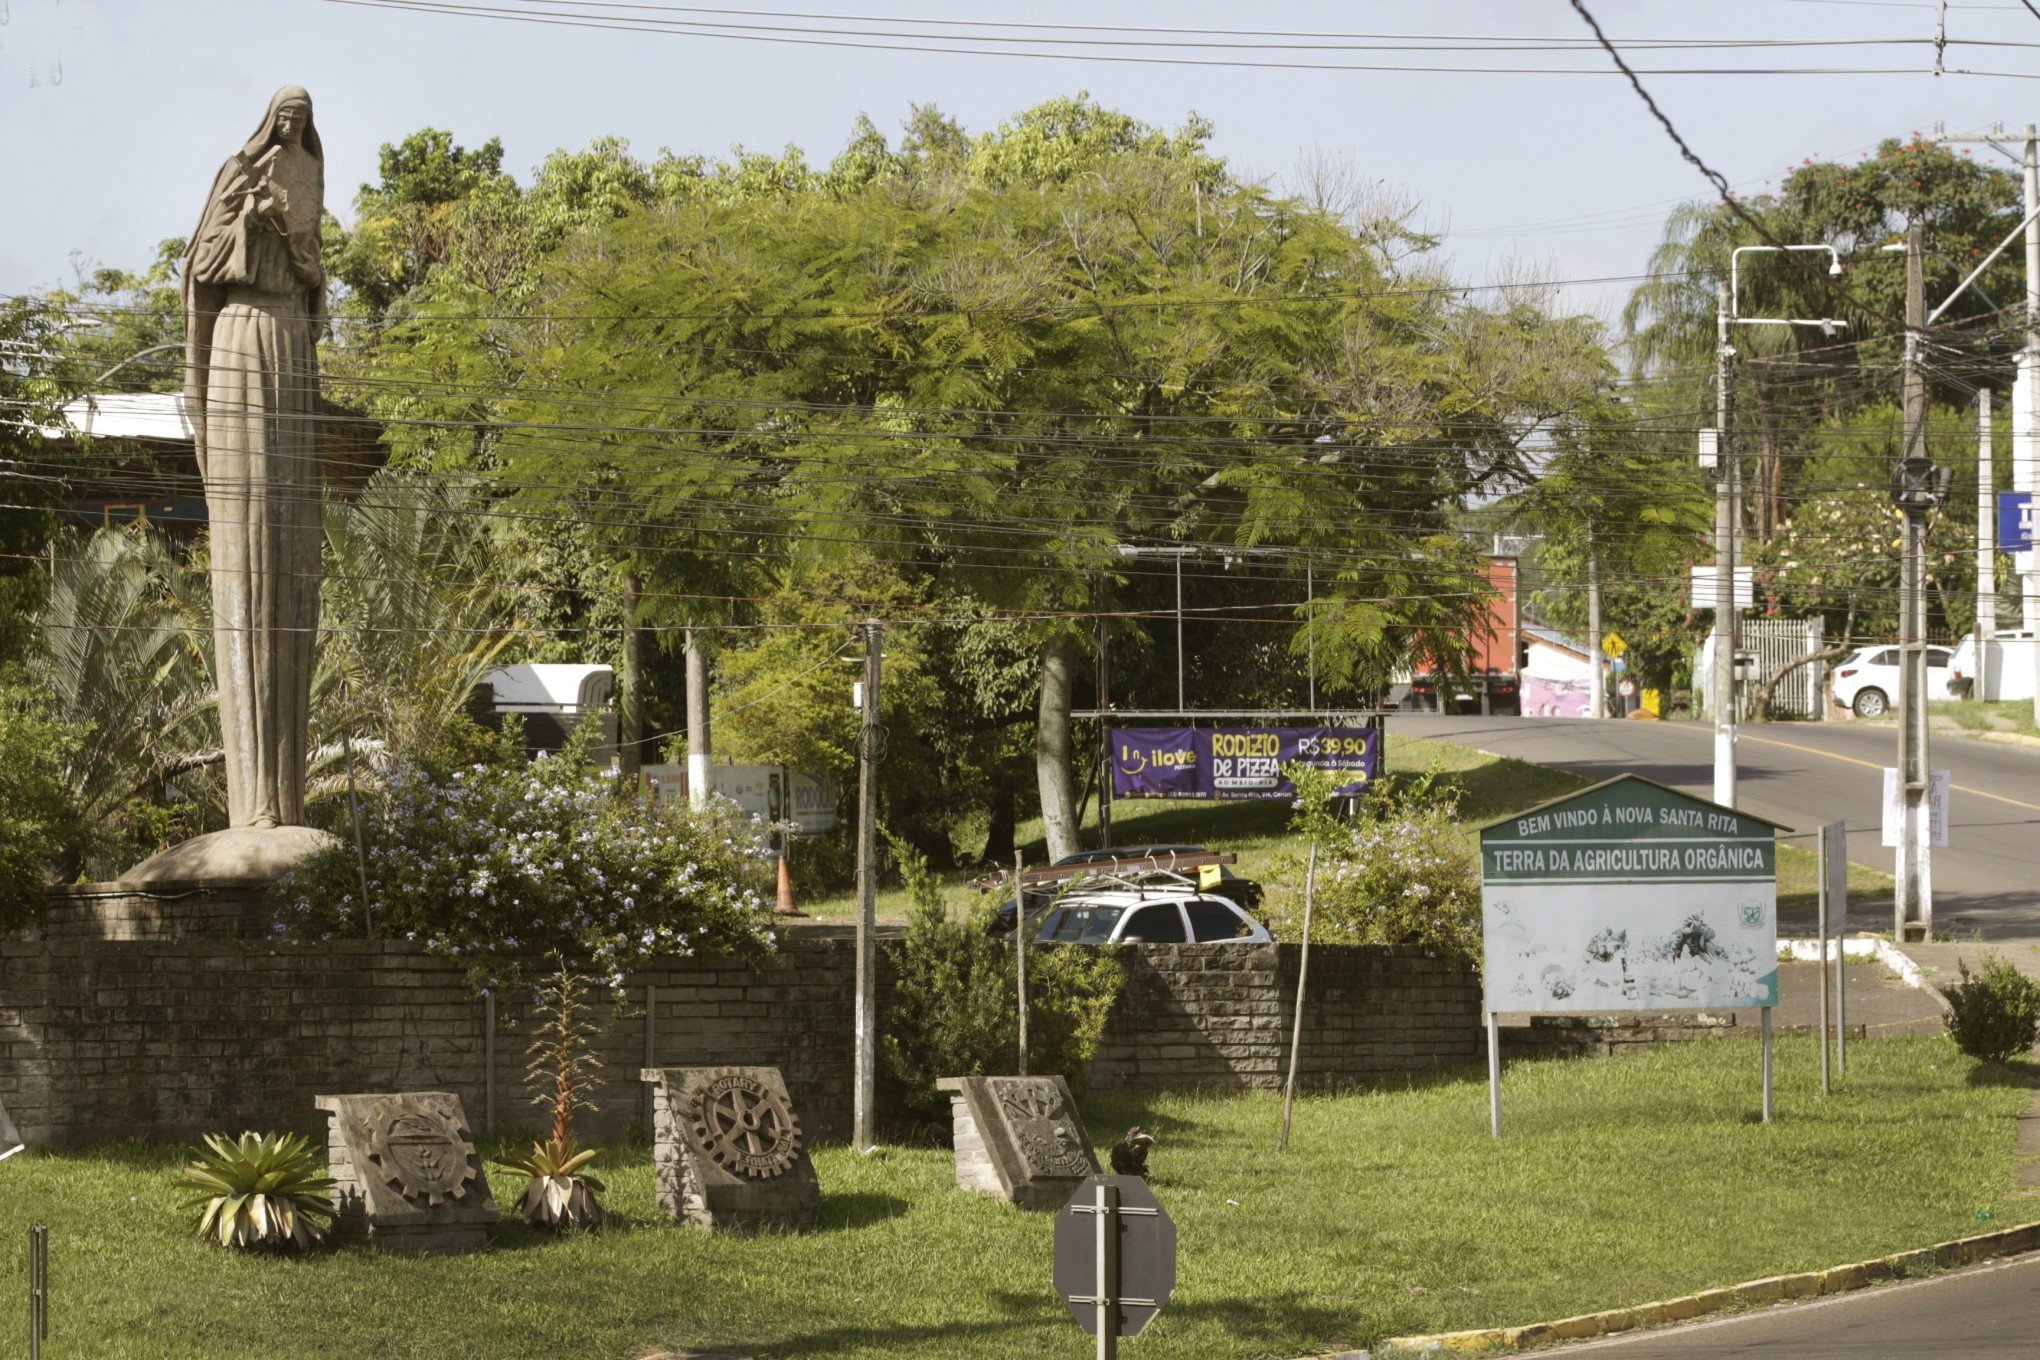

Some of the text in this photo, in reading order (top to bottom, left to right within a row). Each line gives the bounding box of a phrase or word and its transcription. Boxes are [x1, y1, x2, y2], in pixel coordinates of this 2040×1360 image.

[1300, 759, 1330, 769] egunda
[1518, 803, 1738, 837] BEM VINDO À NOVA SANTA RITA
[1494, 843, 1764, 871] TERRA DA AGRICULTURA ORGÂNICA
[711, 1077, 757, 1095] ROTARY
